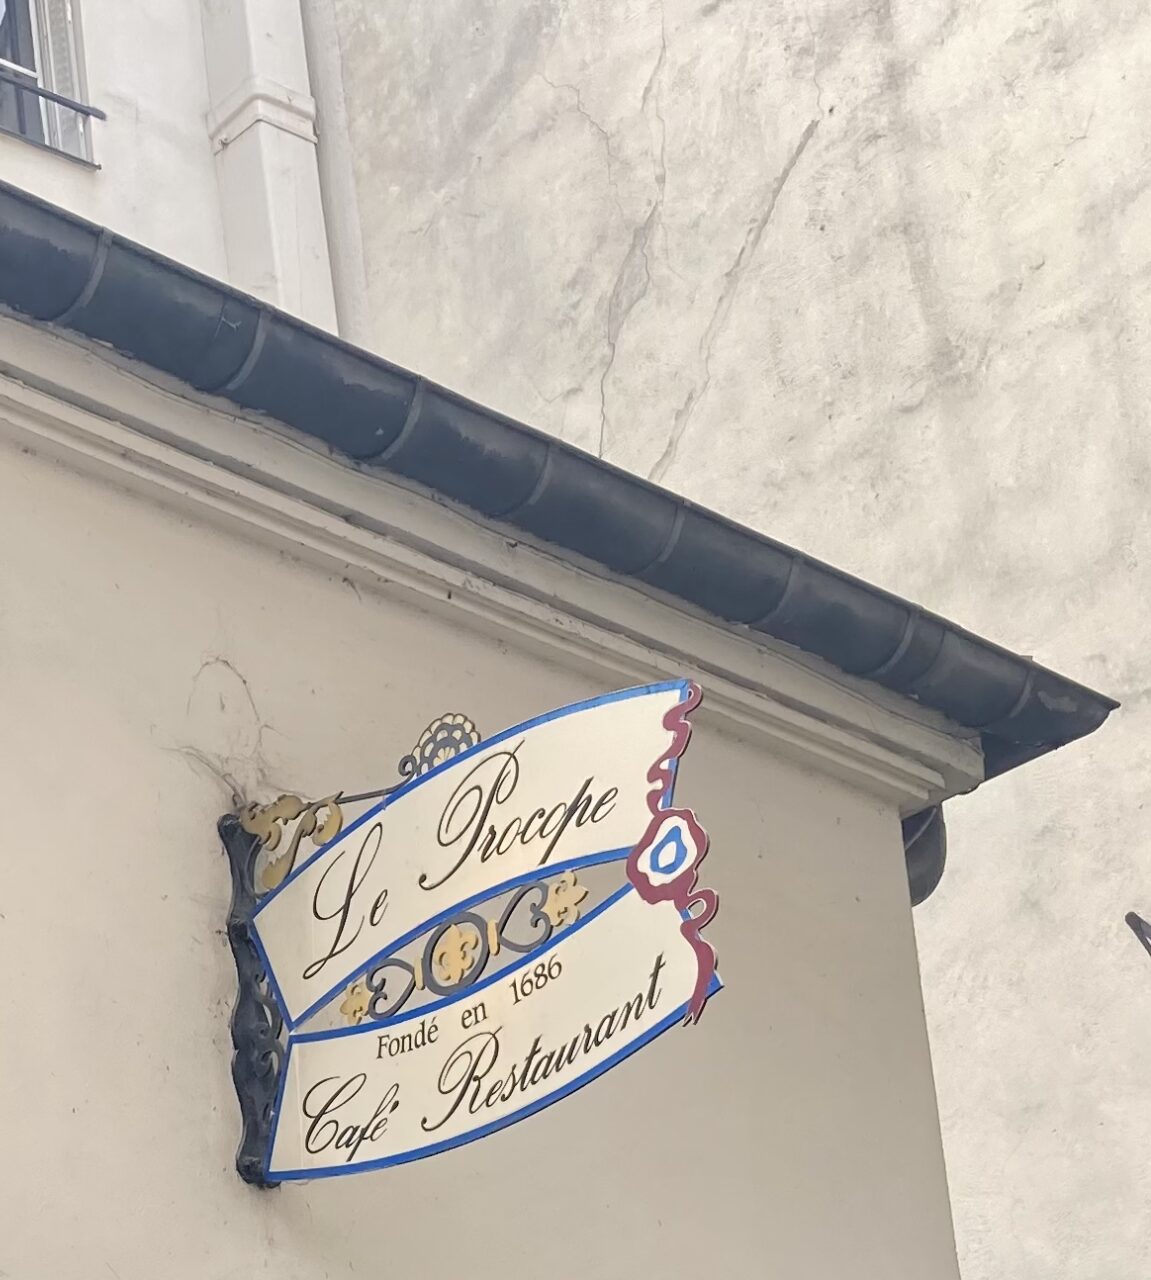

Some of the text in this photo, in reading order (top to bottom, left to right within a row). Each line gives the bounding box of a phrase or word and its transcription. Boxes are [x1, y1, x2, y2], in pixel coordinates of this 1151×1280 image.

[302, 739, 618, 980] Le Procope
[302, 951, 667, 1162] Café Restaurant
[376, 954, 564, 1060] Fondé en 1686
